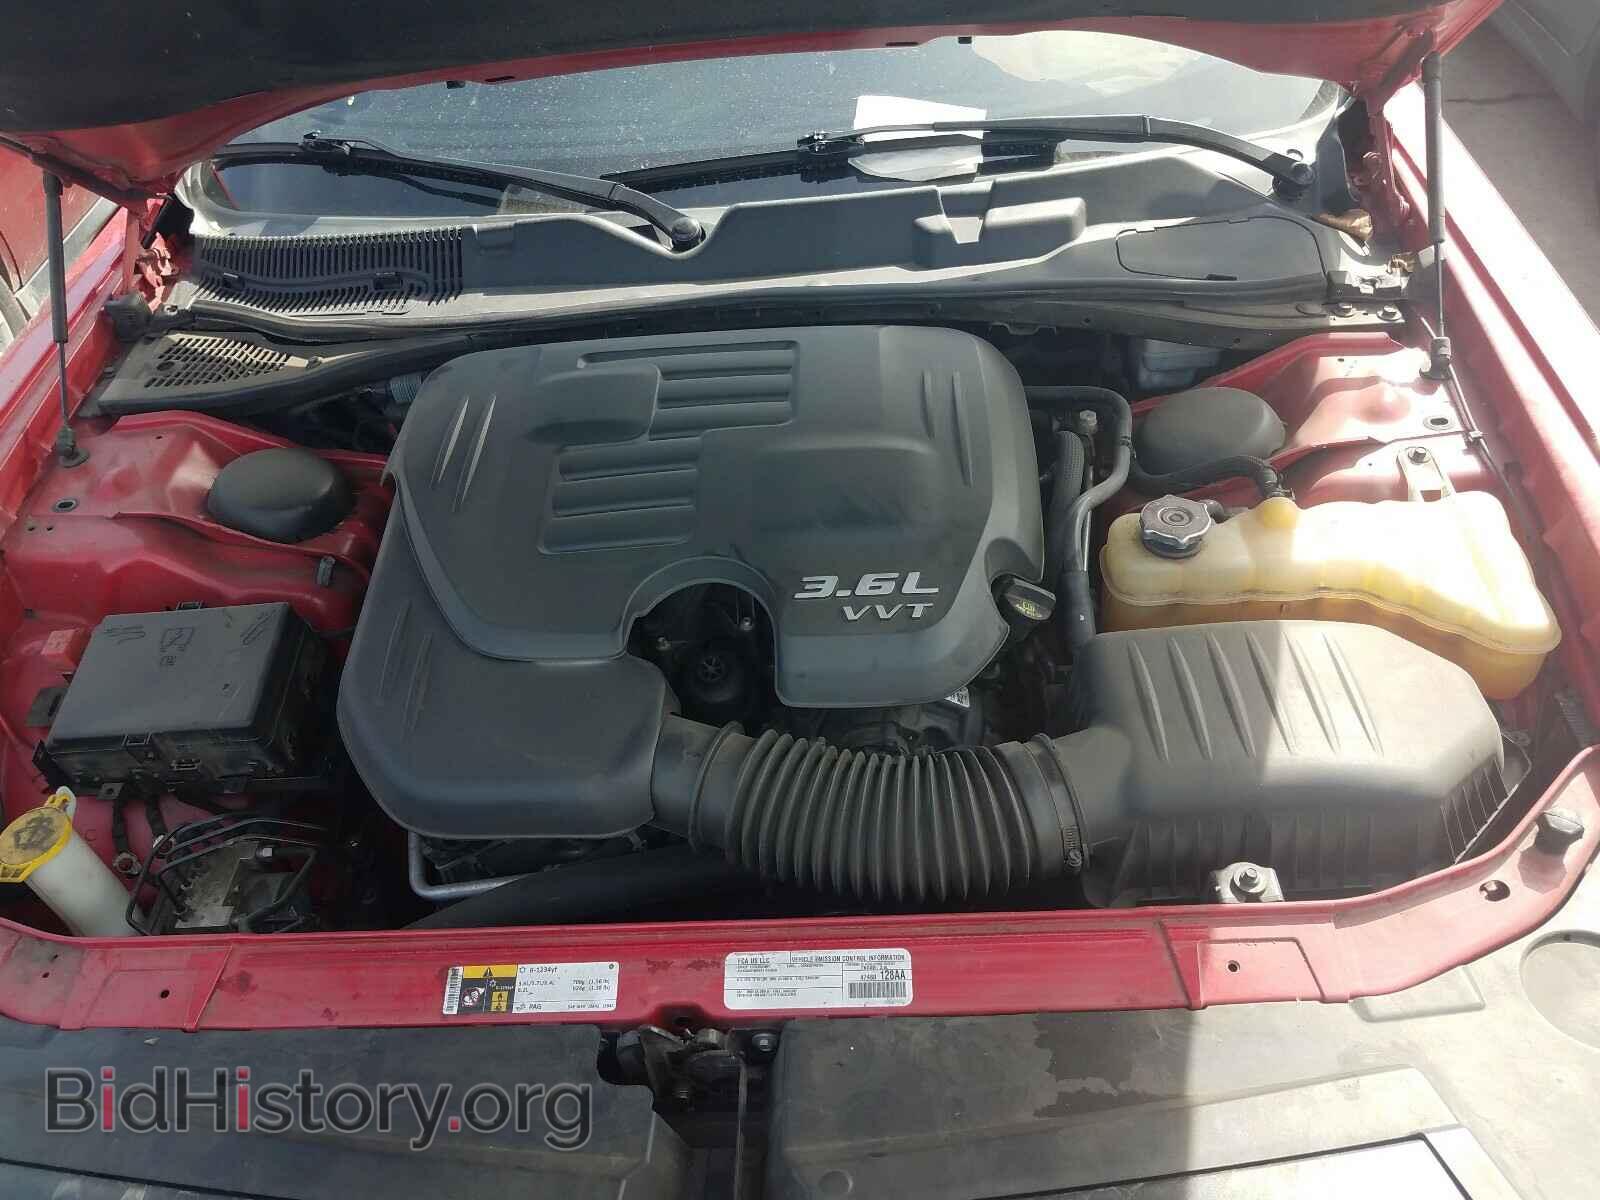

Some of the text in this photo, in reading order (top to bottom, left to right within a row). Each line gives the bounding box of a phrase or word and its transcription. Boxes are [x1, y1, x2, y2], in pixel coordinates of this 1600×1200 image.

[794, 571, 940, 599] 3.6L
[842, 602, 934, 621] VVT
[880, 969, 906, 980] 128AA
